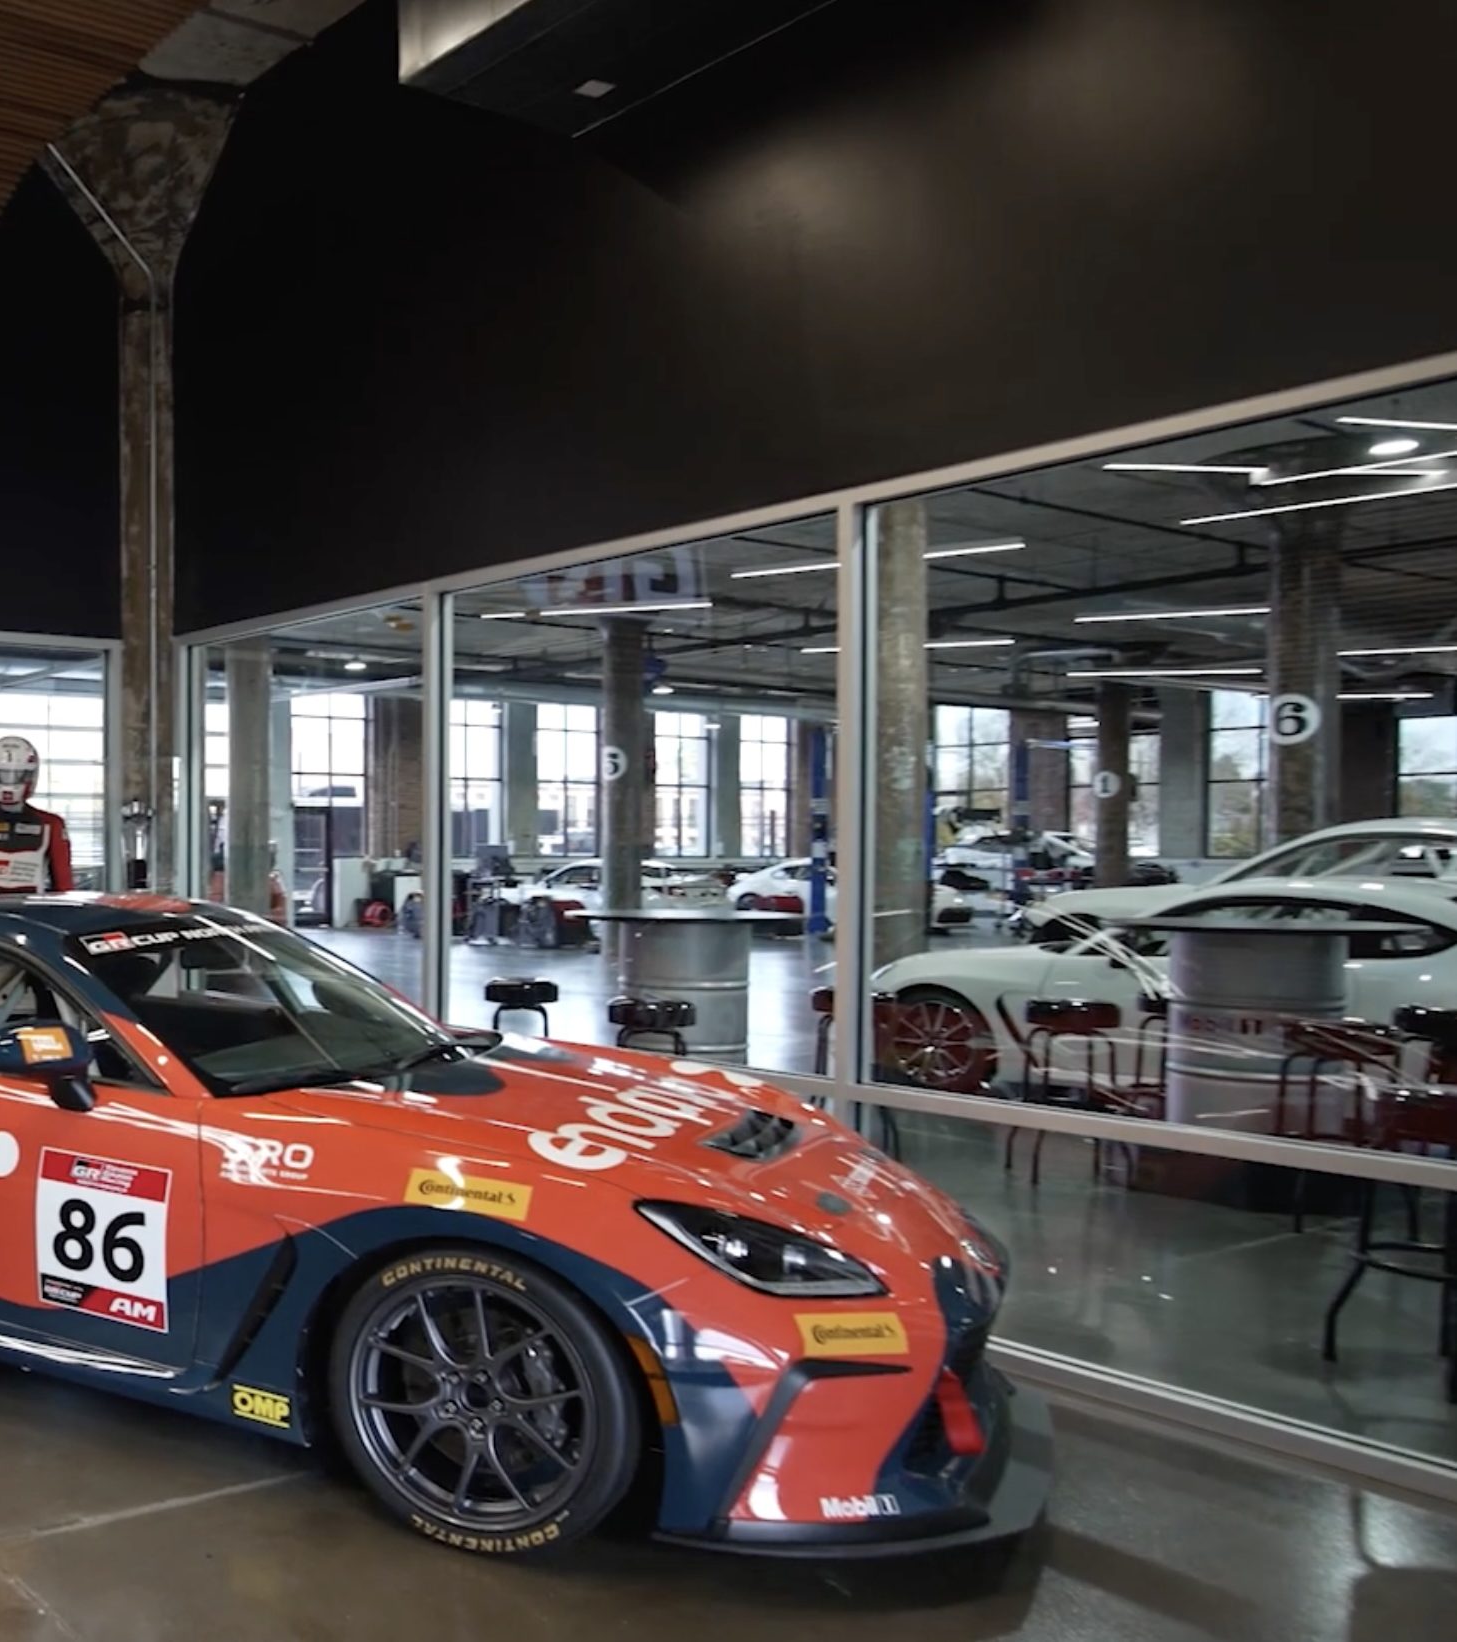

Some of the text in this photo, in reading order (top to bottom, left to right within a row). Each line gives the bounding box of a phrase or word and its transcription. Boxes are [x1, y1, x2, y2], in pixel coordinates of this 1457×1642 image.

[1275, 701, 1308, 736] 6
[131, 931, 180, 946] CUP
[418, 1179, 503, 1204] Continental
[53, 1198, 146, 1283] 86
[381, 1257, 527, 1292] CONTINENTAL
[109, 1297, 157, 1322] AM
[233, 1391, 291, 1421] OMP
[819, 1495, 880, 1519] Mobil
[411, 1513, 561, 1552] CONTINENTAL
